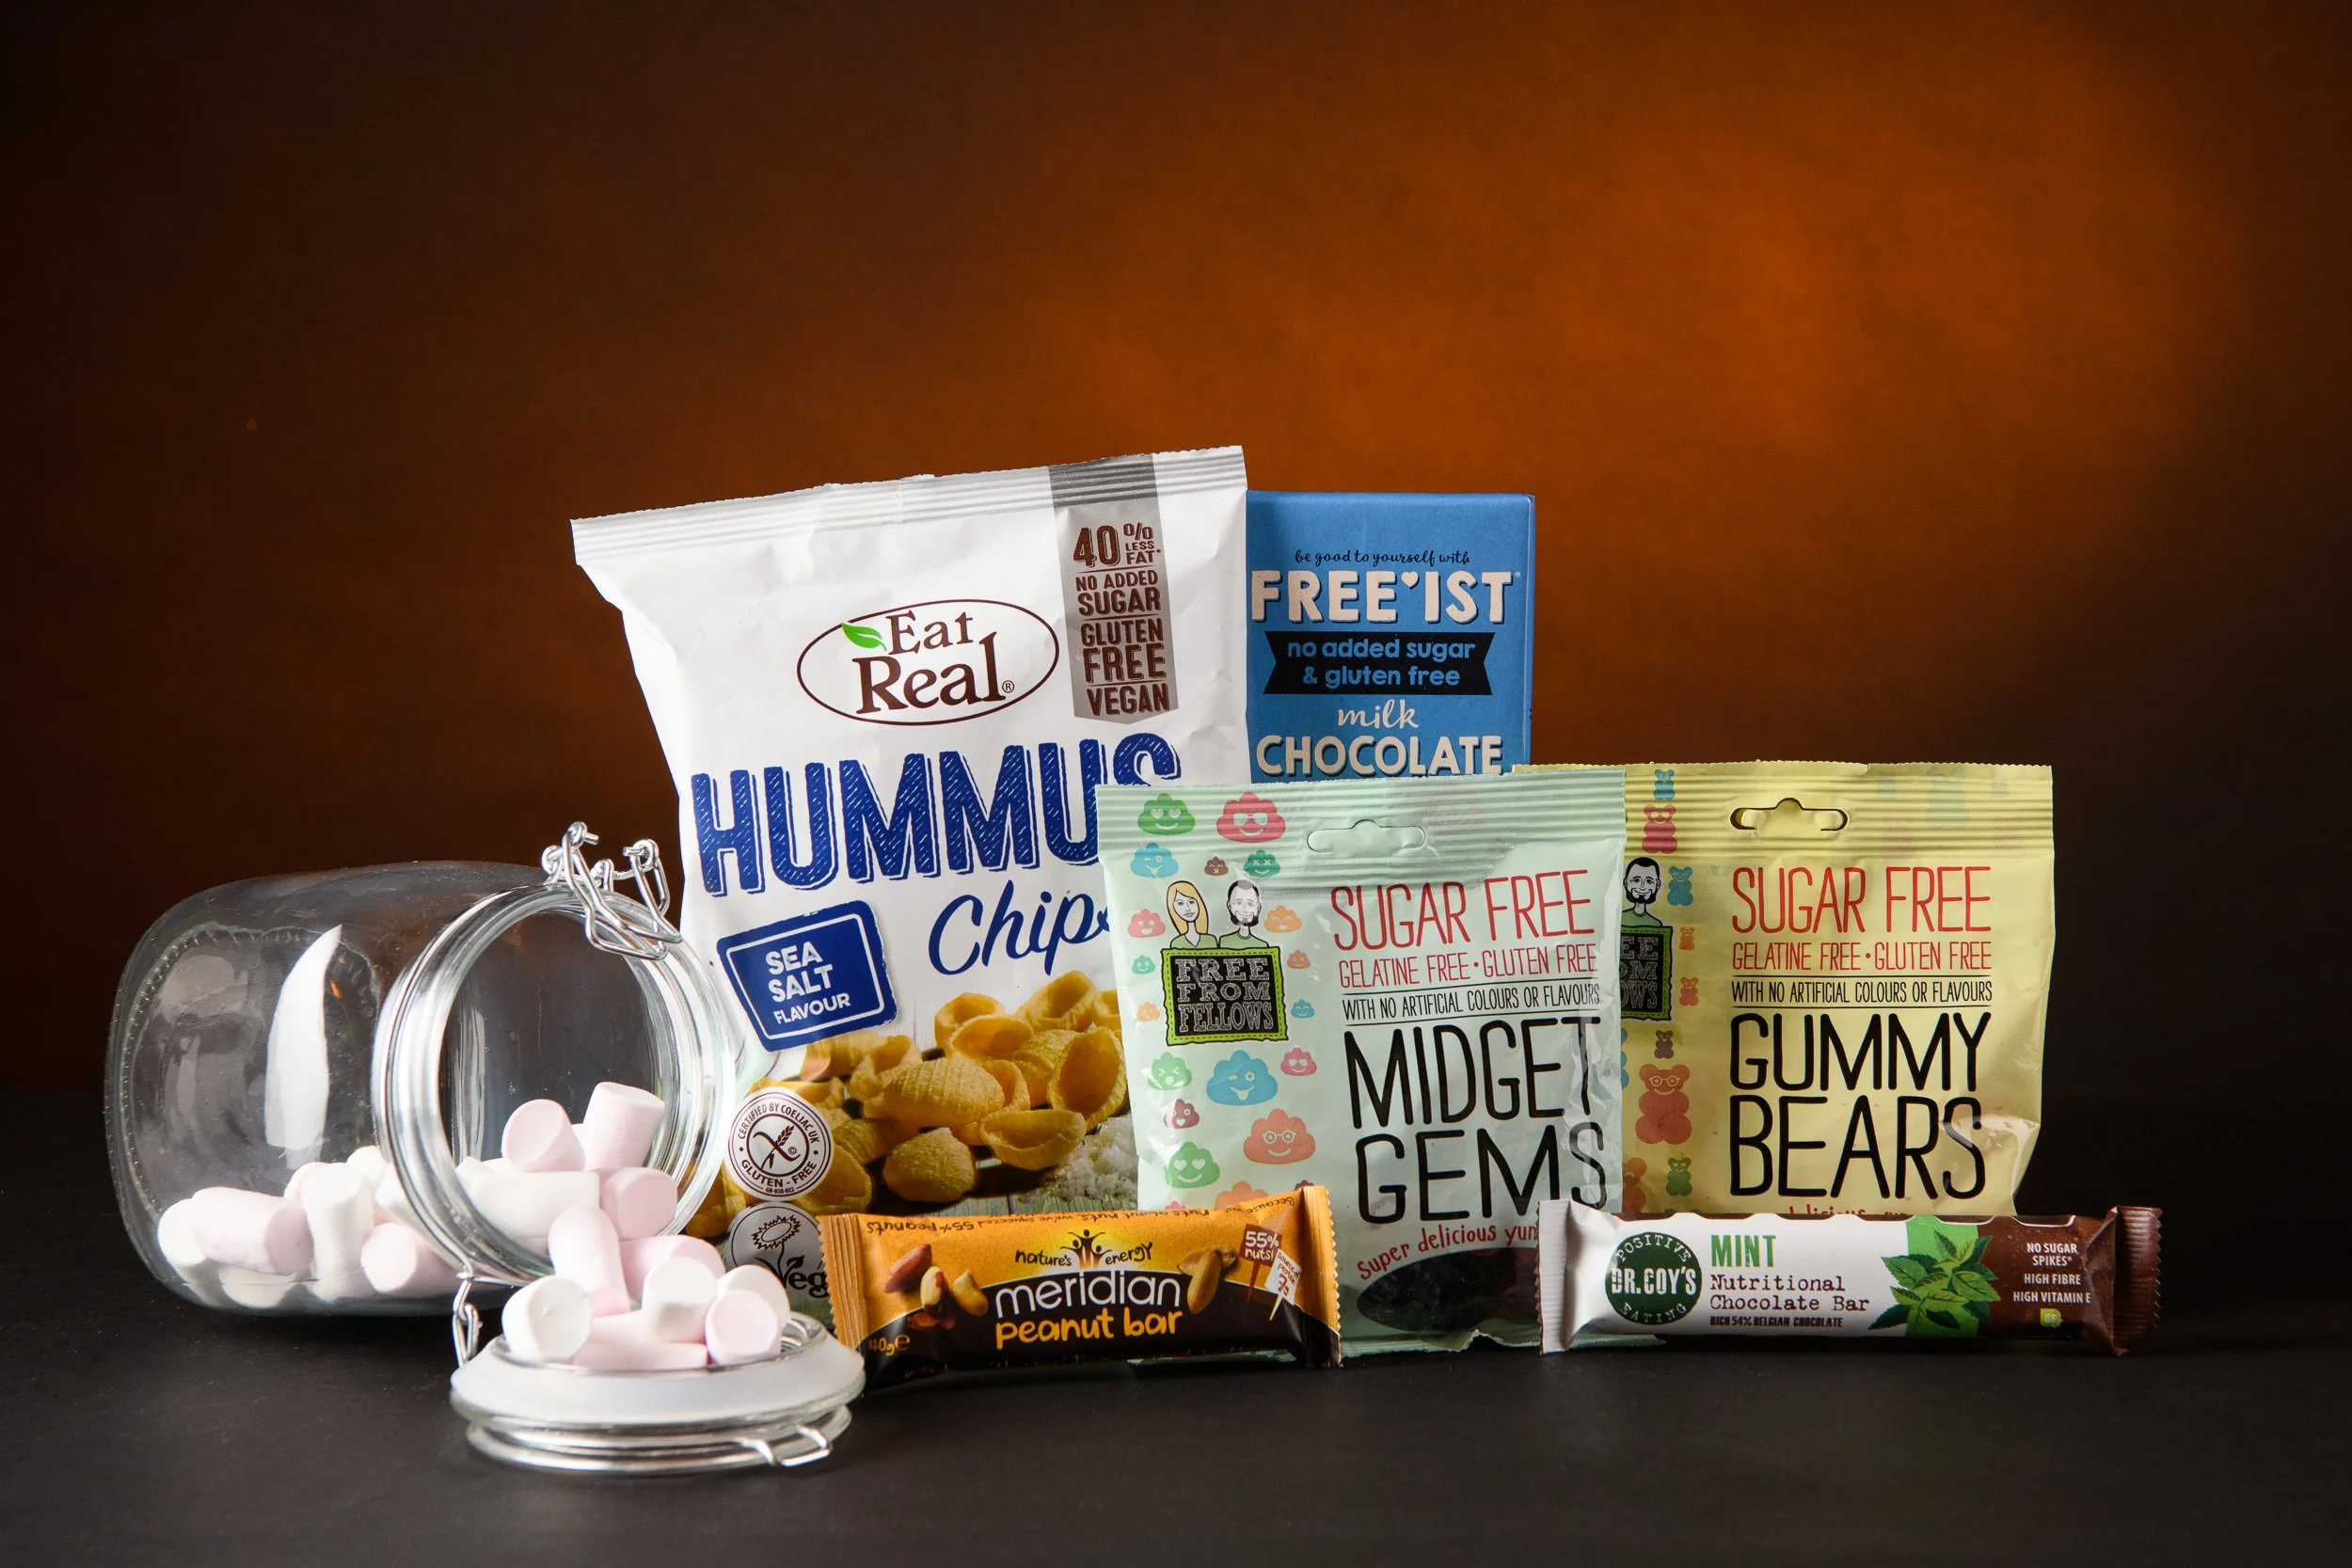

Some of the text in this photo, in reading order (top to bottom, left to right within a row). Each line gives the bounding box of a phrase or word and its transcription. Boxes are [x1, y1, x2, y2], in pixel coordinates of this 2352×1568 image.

[1125, 541, 1155, 551] LESS
[1295, 549, 1470, 567] be good to yourself with
[1075, 569, 1159, 592] NO ADDED
[1077, 586, 1162, 617] SUGAR
[885, 610, 974, 656] Eat
[1080, 617, 1164, 648] GLUTEN
[1083, 642, 1167, 684] FREE
[1287, 639, 1476, 663] no added sugar
[1302, 666, 1461, 689] & gluten free
[1086, 683, 1170, 717] VEGAN
[1337, 698, 1420, 729] milk
[1256, 735, 1505, 777] CHOCOLATE
[1330, 869, 1596, 951] SUGAR FREE
[1731, 865, 1992, 934] SUGAR FREE
[929, 879, 1108, 975] Chip
[765, 941, 823, 975] SEA
[1175, 958, 1270, 982] FREE
[1339, 953, 1422, 989] GELATINE
[1428, 950, 1470, 980] FREE
[1483, 946, 1550, 977] GLUTEN
[1556, 944, 1598, 973] FREE
[1731, 942, 1992, 971] GELATINE FREE GLUTEN FREE
[768, 964, 834, 1003] SALT
[1176, 981, 1271, 1003] FROM
[1731, 980, 1994, 1004] WITH NO ARTIFICIAL COLOURS OR FLAVOURS
[773, 992, 851, 1024] FLAVOUR
[1178, 1001, 1274, 1033] FELLOWS
[1343, 997, 1376, 1021] WITH
[1380, 997, 1398, 1019] NO
[1402, 990, 1462, 1017] ARTIFICIAL
[1467, 988, 1518, 1011] COLOURS
[1523, 987, 1540, 1008] OR
[1543, 983, 1600, 1007] FLAVOURS
[1729, 1012, 1992, 1092] GUMMY
[1343, 1016, 1601, 1129] MIDGET
[738, 1102, 820, 1145] CERTIFIED BY COELIAC UK
[1729, 1094, 1987, 1200] BEARS
[741, 1159, 784, 1188] GLUTEN
[791, 1161, 818, 1185] FREE
[1355, 1122, 1608, 1223] GEMS
[1245, 1230, 1279, 1249] 55%
[1245, 1247, 1275, 1261] nuts!
[1418, 1224, 1497, 1253] delicious
[1615, 1234, 1692, 1262] POSITIVE
[1710, 1234, 1776, 1268] MINT
[2026, 1243, 2078, 1254] NO SUGAR
[1015, 1248, 1073, 1267] nature's
[995, 1271, 1182, 1319] meridian
[1709, 1274, 1846, 1292] Nutritional
[2024, 1273, 2082, 1286] HIGH FIBRE
[1618, 1302, 1688, 1323] EATING
[1709, 1294, 1870, 1312] Chocolate Bar
[2012, 1291, 2091, 1304] HIGH VITAMIN E
[995, 1307, 1184, 1351] peanut bar
[1709, 1316, 1844, 1328] RICH 54% BELGIAN CHOCOLATE
